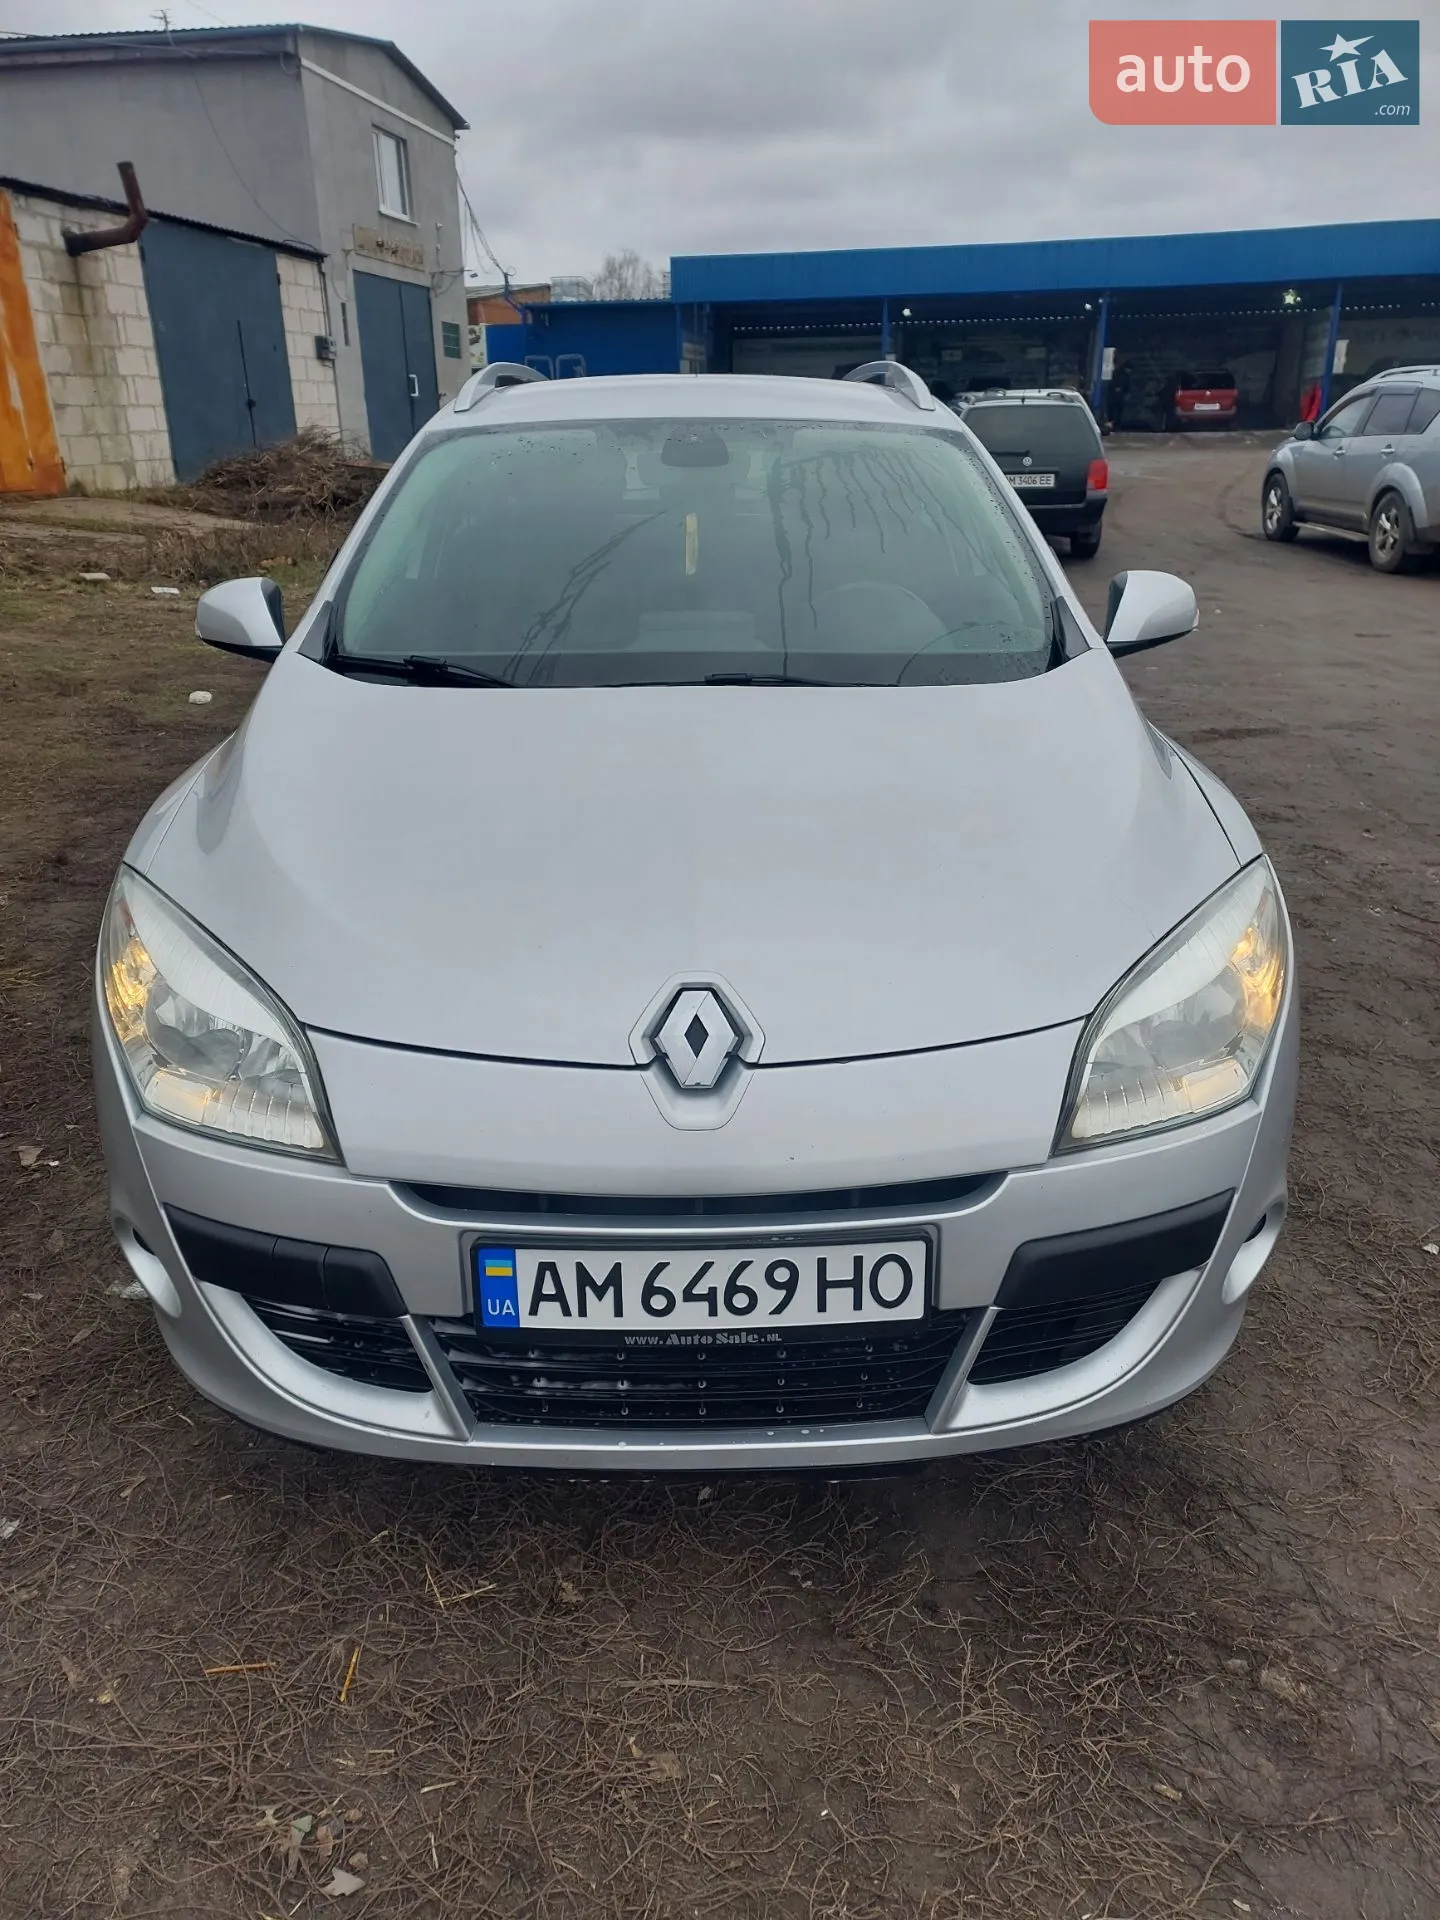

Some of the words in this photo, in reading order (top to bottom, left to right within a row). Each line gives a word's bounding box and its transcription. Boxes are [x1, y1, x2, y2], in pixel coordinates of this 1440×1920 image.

[1018, 476, 1037, 485] 3406
[1039, 476, 1052, 485] EE
[528, 1261, 624, 1318] AM
[640, 1258, 800, 1318] 6469
[816, 1253, 914, 1314] HO
[487, 1299, 516, 1316] UA
